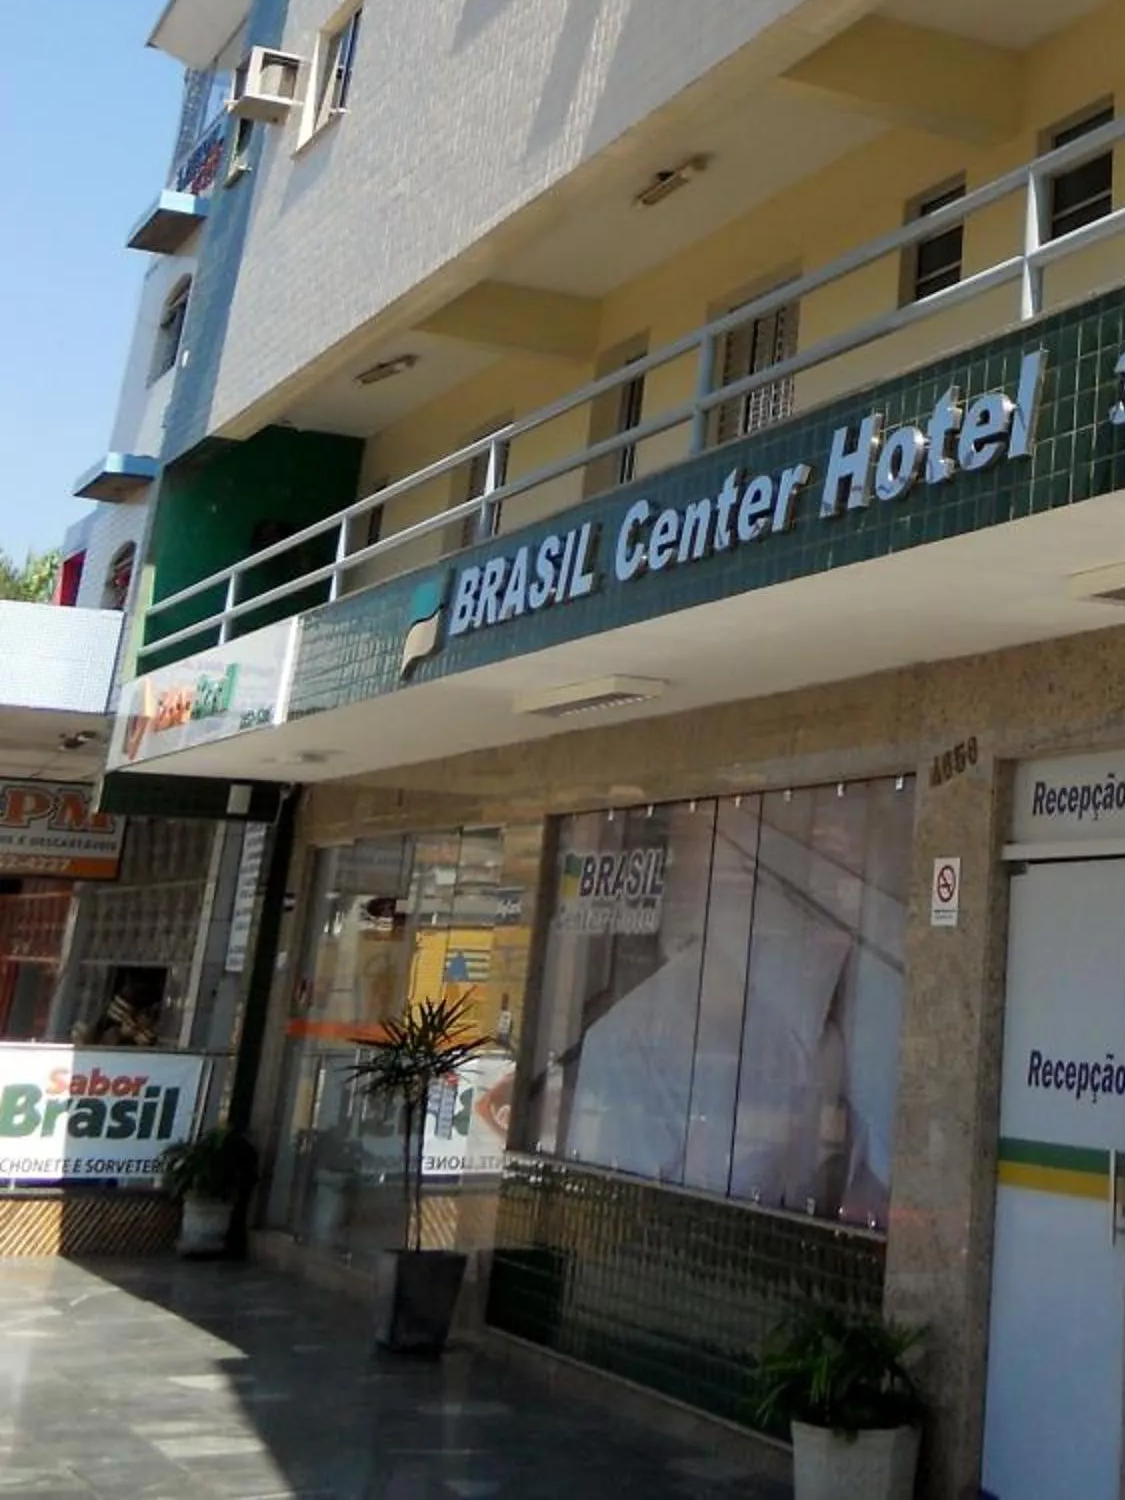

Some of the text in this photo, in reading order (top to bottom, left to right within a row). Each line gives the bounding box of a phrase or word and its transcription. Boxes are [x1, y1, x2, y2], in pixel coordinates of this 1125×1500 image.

[448, 521, 593, 635] BRASIL
[614, 460, 811, 578] Center
[820, 348, 1046, 519] Hotel
[579, 850, 665, 897] BRASIL
[46, 1068, 149, 1097] Sabor
[0, 1084, 181, 1140] Brasil
